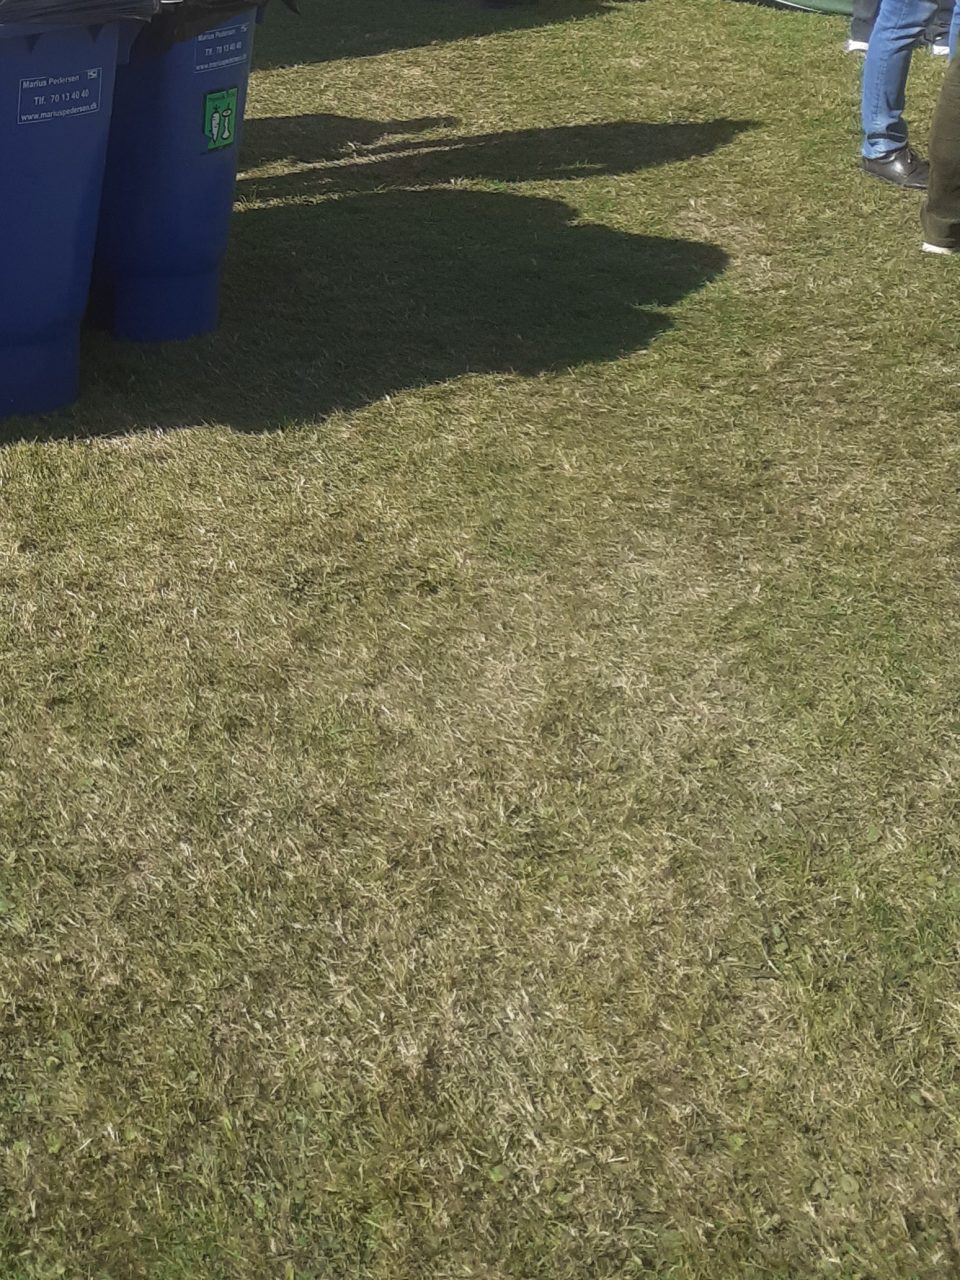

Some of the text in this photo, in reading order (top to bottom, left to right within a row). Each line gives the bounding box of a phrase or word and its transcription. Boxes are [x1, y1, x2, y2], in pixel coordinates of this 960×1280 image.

[22, 79, 47, 89] Marius
[48, 74, 80, 85] Pedersen
[33, 88, 90, 105] Tlf. 70 13 40 40
[20, 101, 98, 121] www.mariuspedersen.dk
